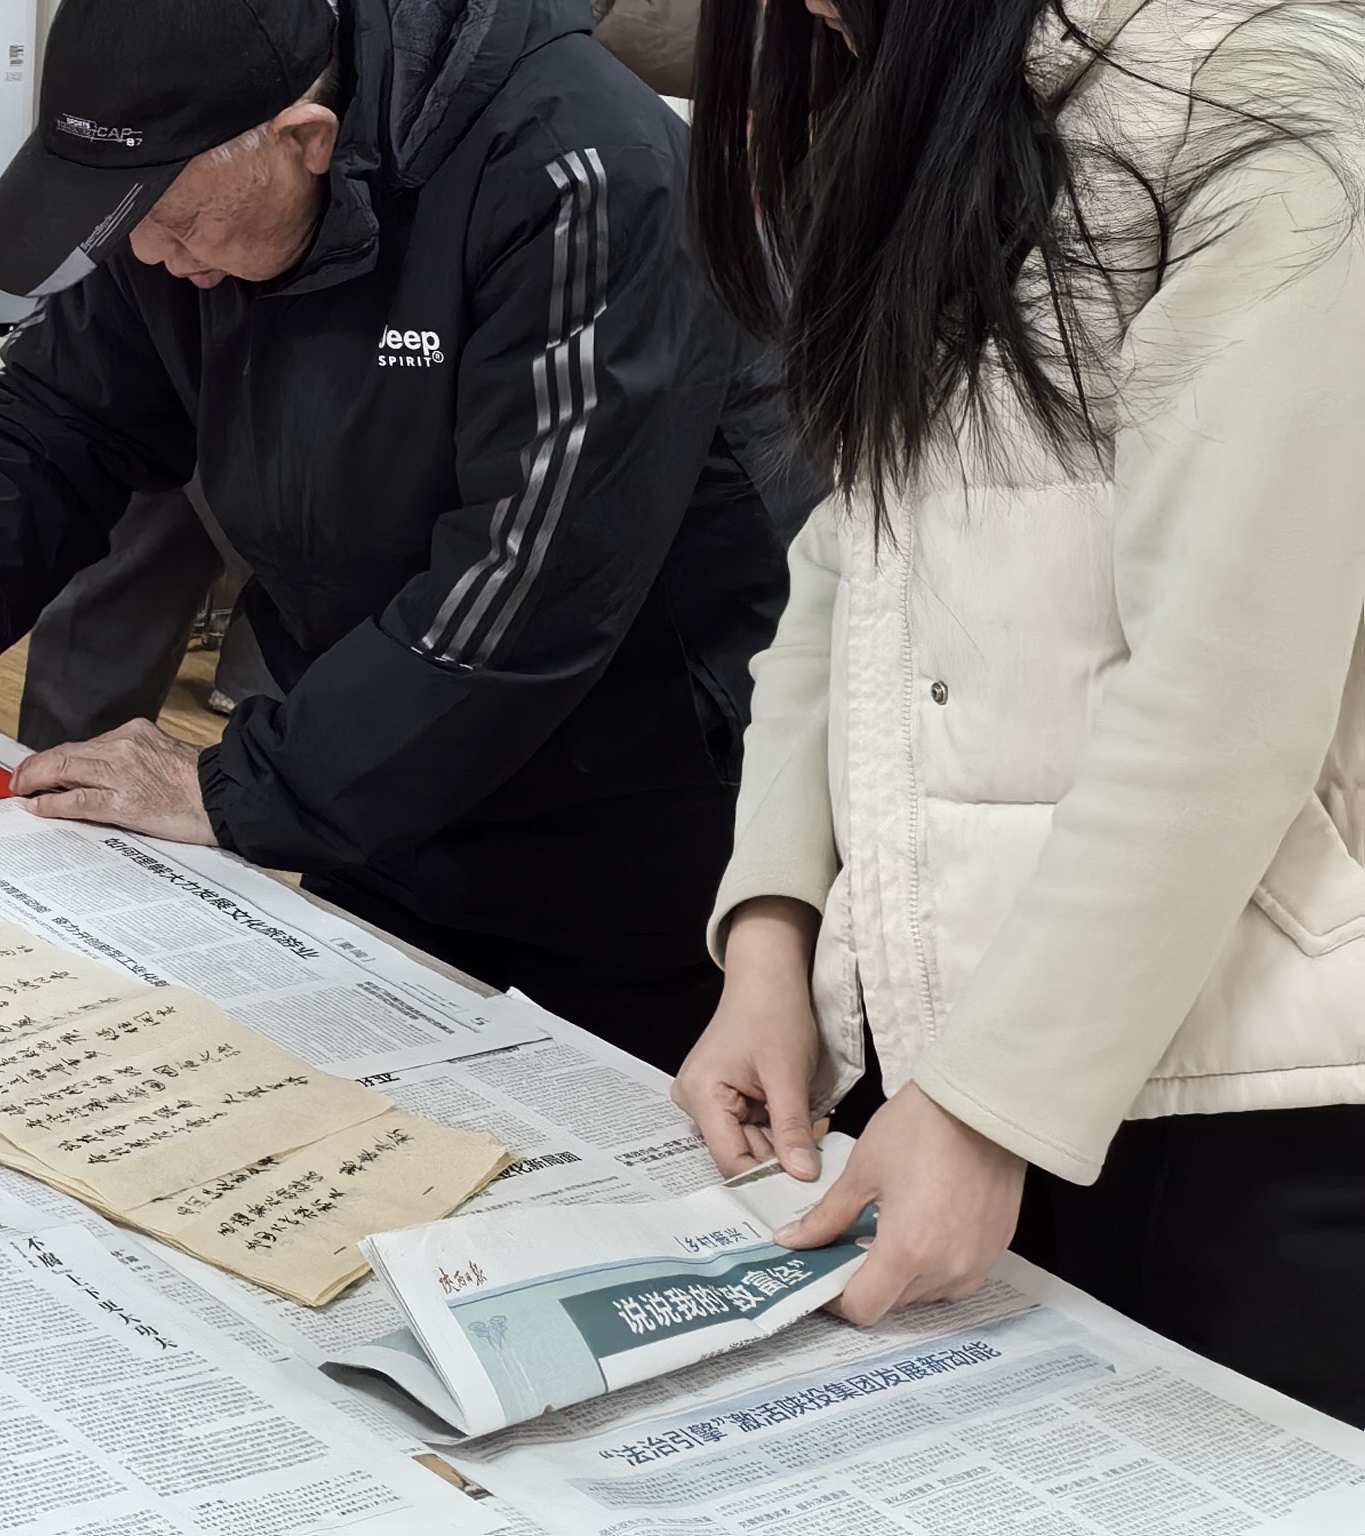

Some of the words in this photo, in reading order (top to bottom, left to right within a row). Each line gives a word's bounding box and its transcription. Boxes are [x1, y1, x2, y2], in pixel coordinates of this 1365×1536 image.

[378, 324, 440, 356] Jeep
[378, 355, 432, 368] SPIRIT
[101, 836, 320, 961] 如何理解大力发展文化旅游业
